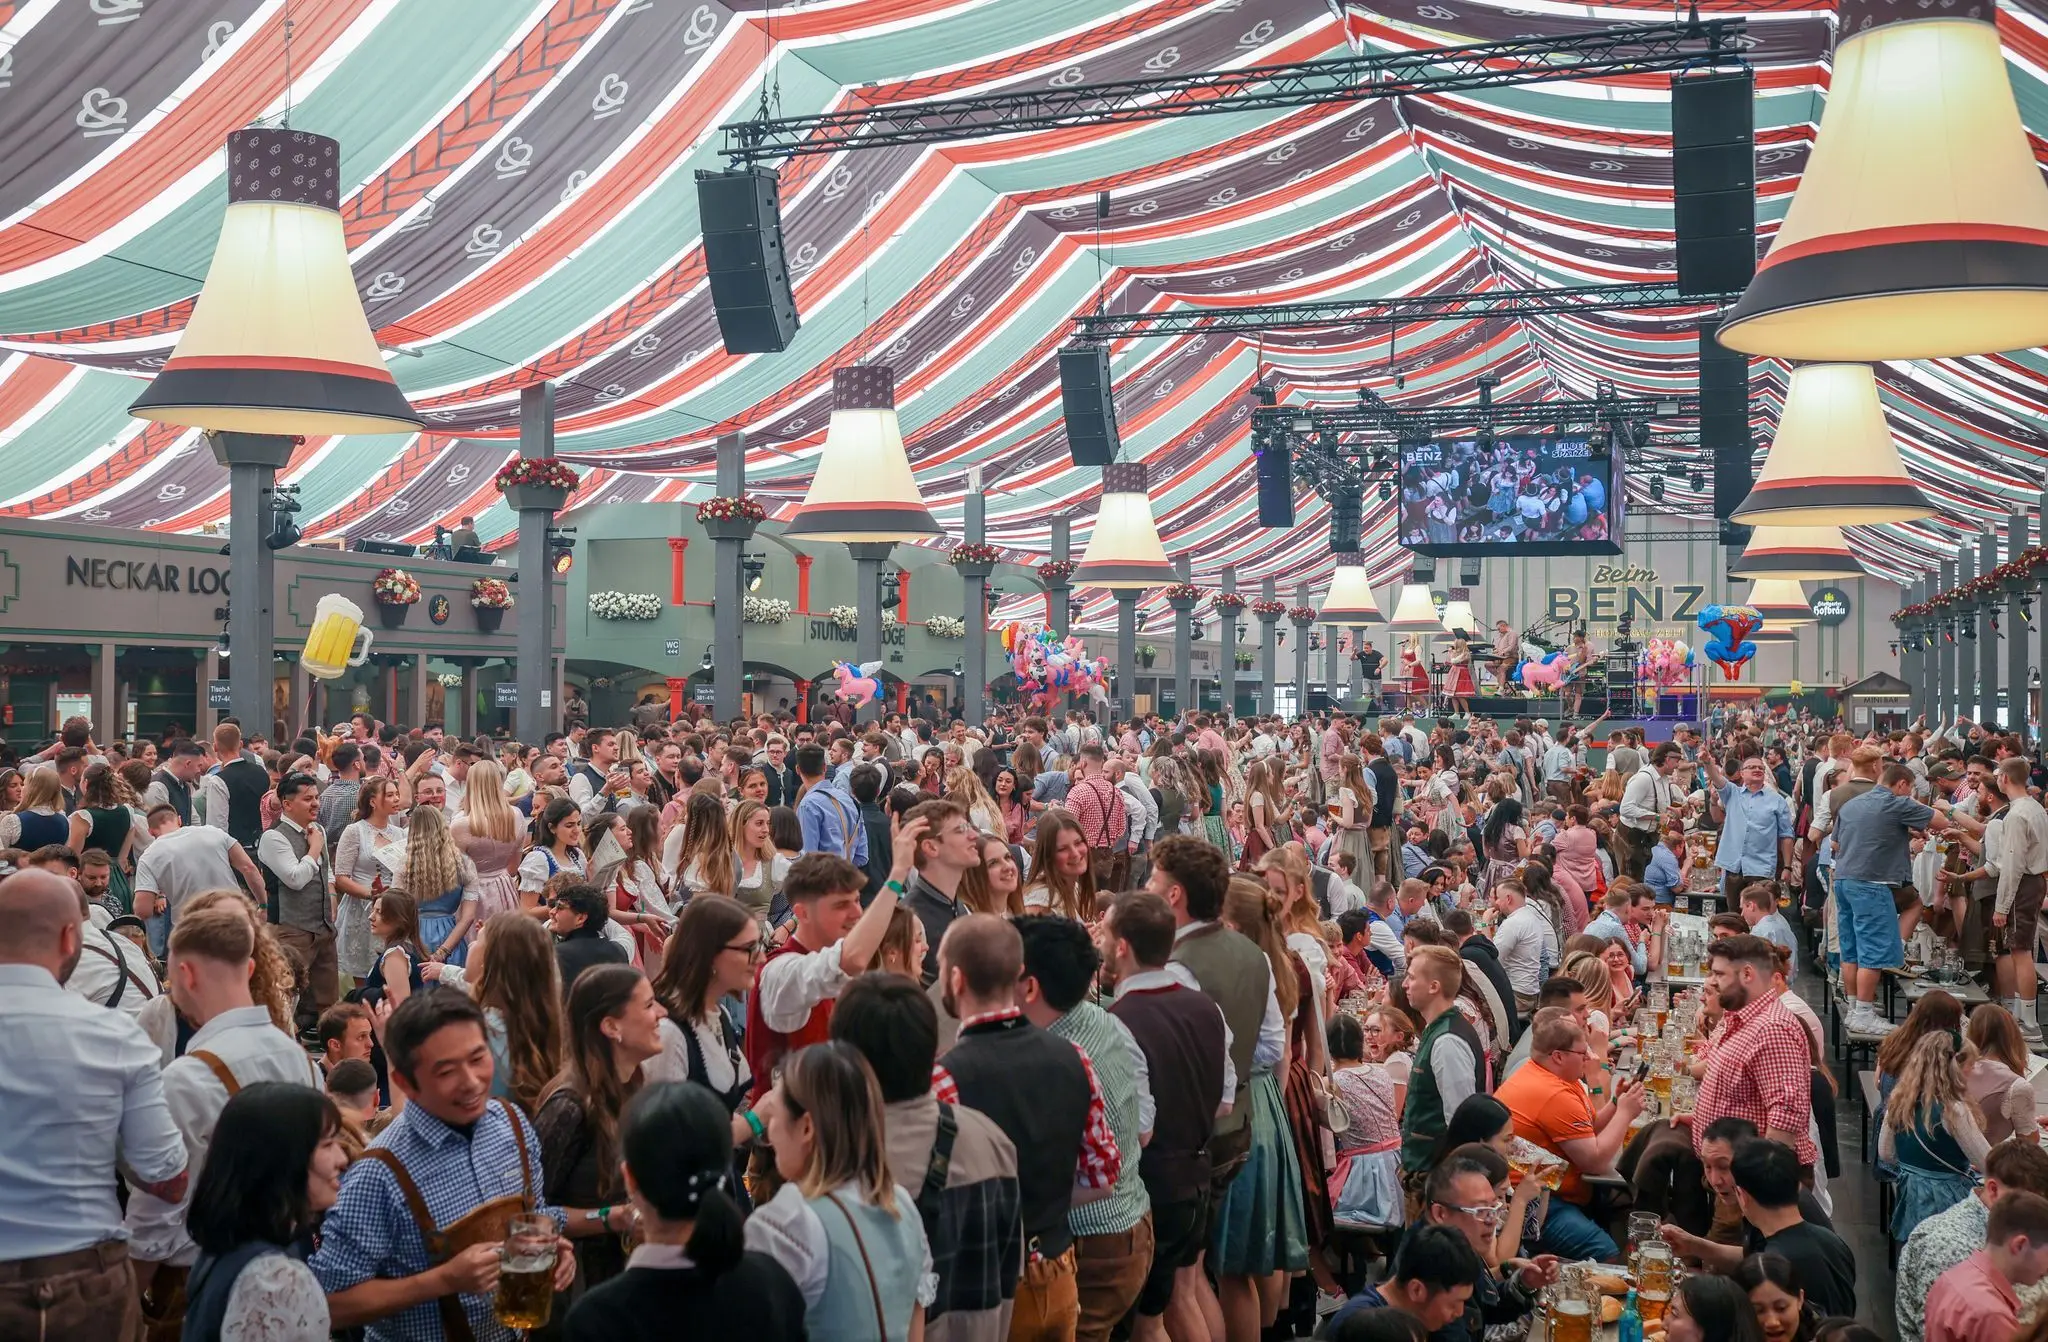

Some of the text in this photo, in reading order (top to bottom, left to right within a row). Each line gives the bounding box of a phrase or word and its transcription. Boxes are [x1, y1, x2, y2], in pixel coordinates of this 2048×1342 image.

[1406, 451, 1443, 461] BENZ
[67, 555, 180, 592] NECKAR
[1593, 564, 1658, 583] Beim
[1549, 585, 1704, 622] BENZ
[1813, 605, 1846, 616] Hofbräu
[666, 641, 679, 649] WC
[881, 628, 905, 645] OGE
